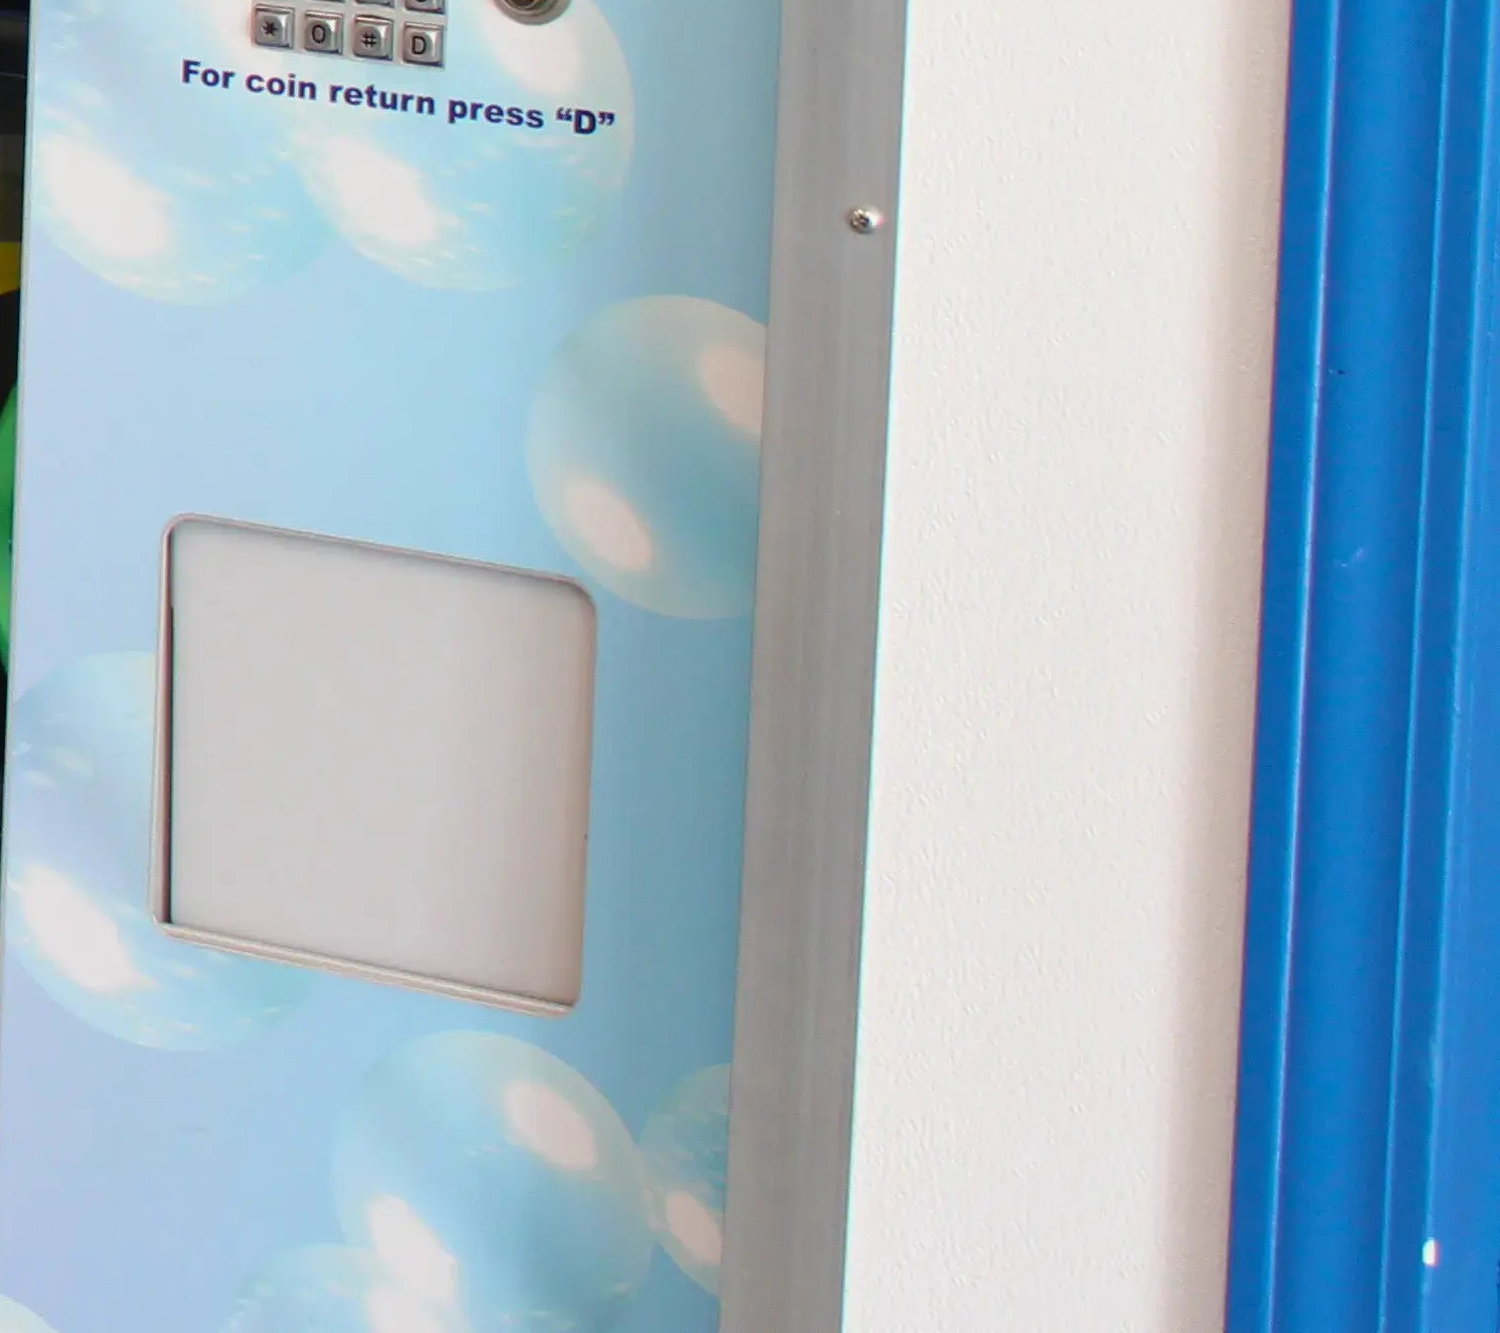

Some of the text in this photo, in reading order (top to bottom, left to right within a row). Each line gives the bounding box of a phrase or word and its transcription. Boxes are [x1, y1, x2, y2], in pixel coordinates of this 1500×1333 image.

[311, 25, 427, 56] 0 # D
[181, 58, 234, 89] For
[245, 72, 317, 101] coin
[329, 83, 436, 116] return
[448, 98, 544, 129] press
